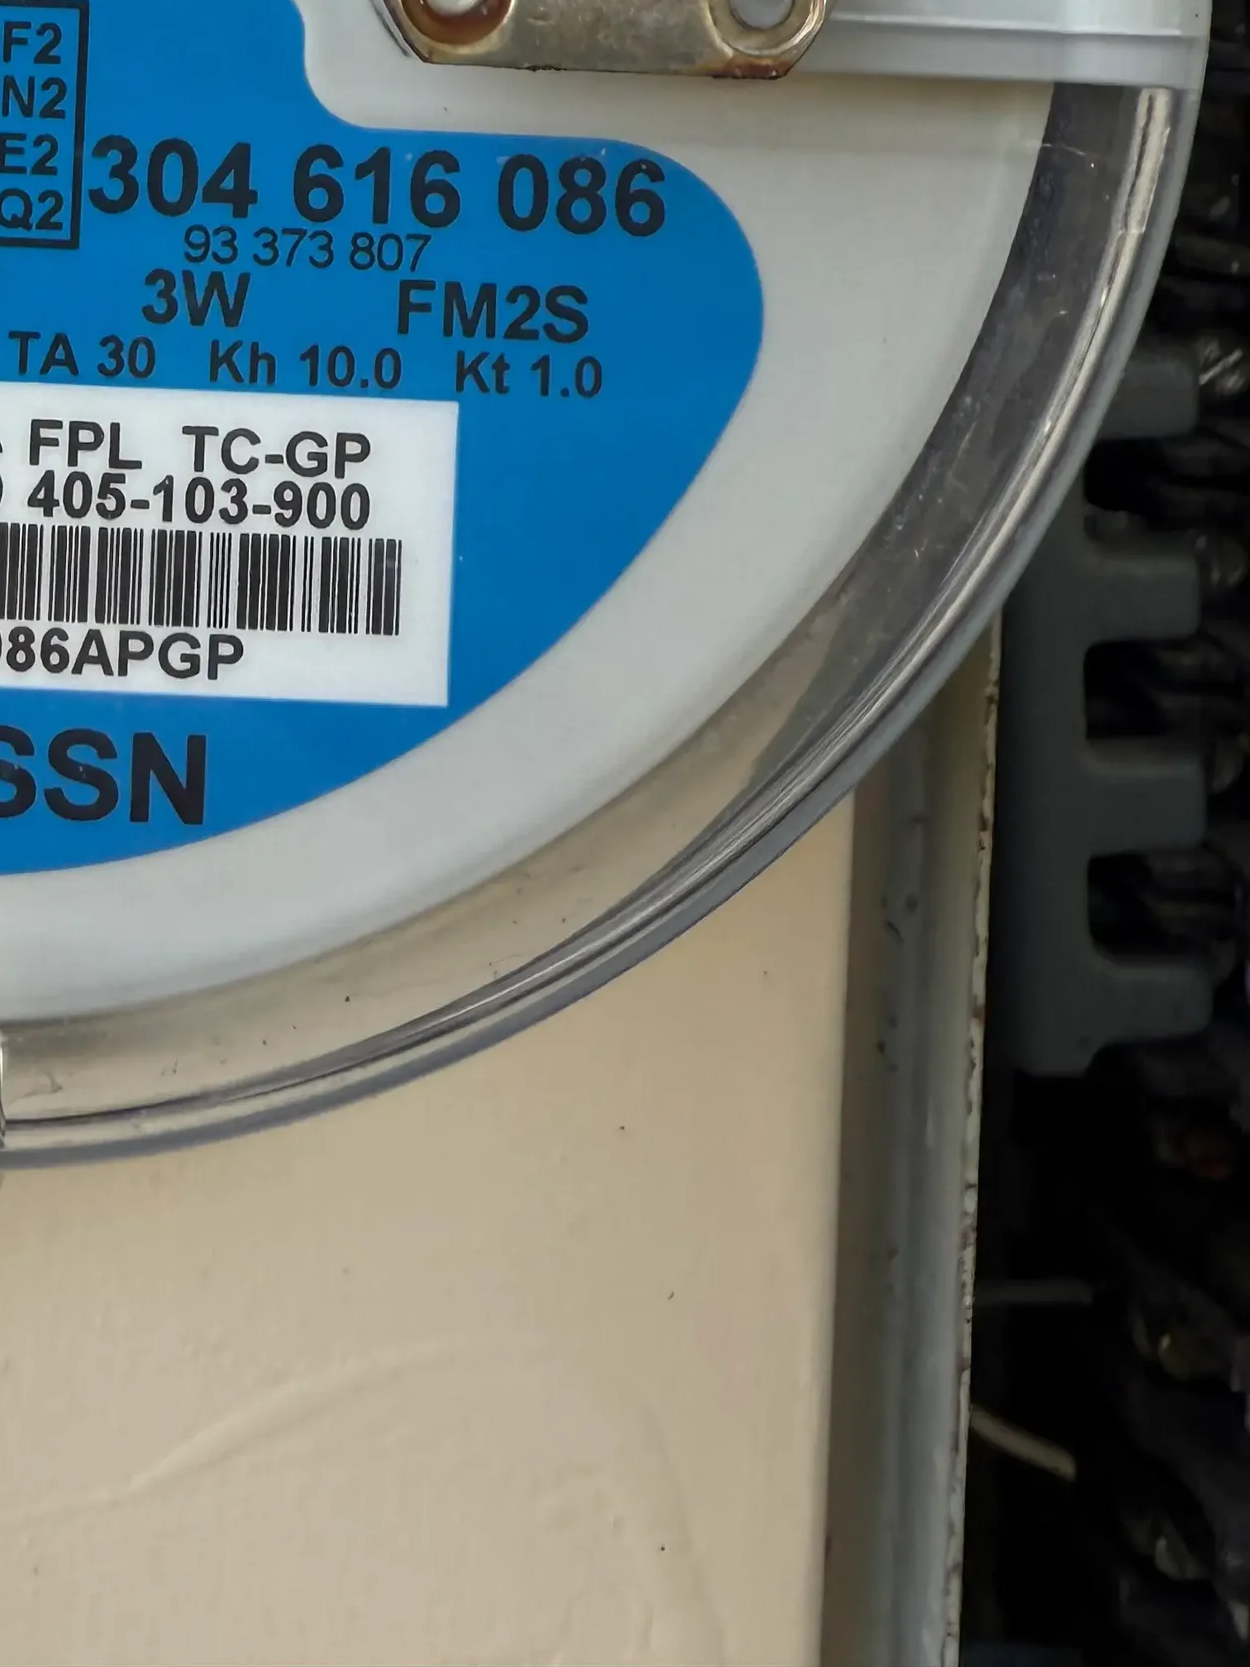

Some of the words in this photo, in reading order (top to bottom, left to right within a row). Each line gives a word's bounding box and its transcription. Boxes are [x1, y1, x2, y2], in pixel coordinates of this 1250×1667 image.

[2, 21, 62, 65] F2
[2, 75, 68, 120] N2
[88, 134, 258, 219] 304
[292, 144, 461, 228] 616
[496, 153, 667, 237] 086
[183, 224, 239, 265] 93
[252, 228, 334, 269] 373
[349, 233, 432, 273] 807
[141, 269, 250, 327] 3W
[397, 279, 590, 343] FM2S
[8, 330, 79, 377] TA
[96, 335, 155, 379] 30
[208, 339, 276, 387] Kh
[299, 344, 402, 390] 10.0
[454, 350, 509, 396] Kt
[530, 354, 603, 398] 1.0
[28, 419, 143, 471] FPL
[182, 424, 372, 480] TC-GP
[27, 469, 371, 531] 405-103-900
